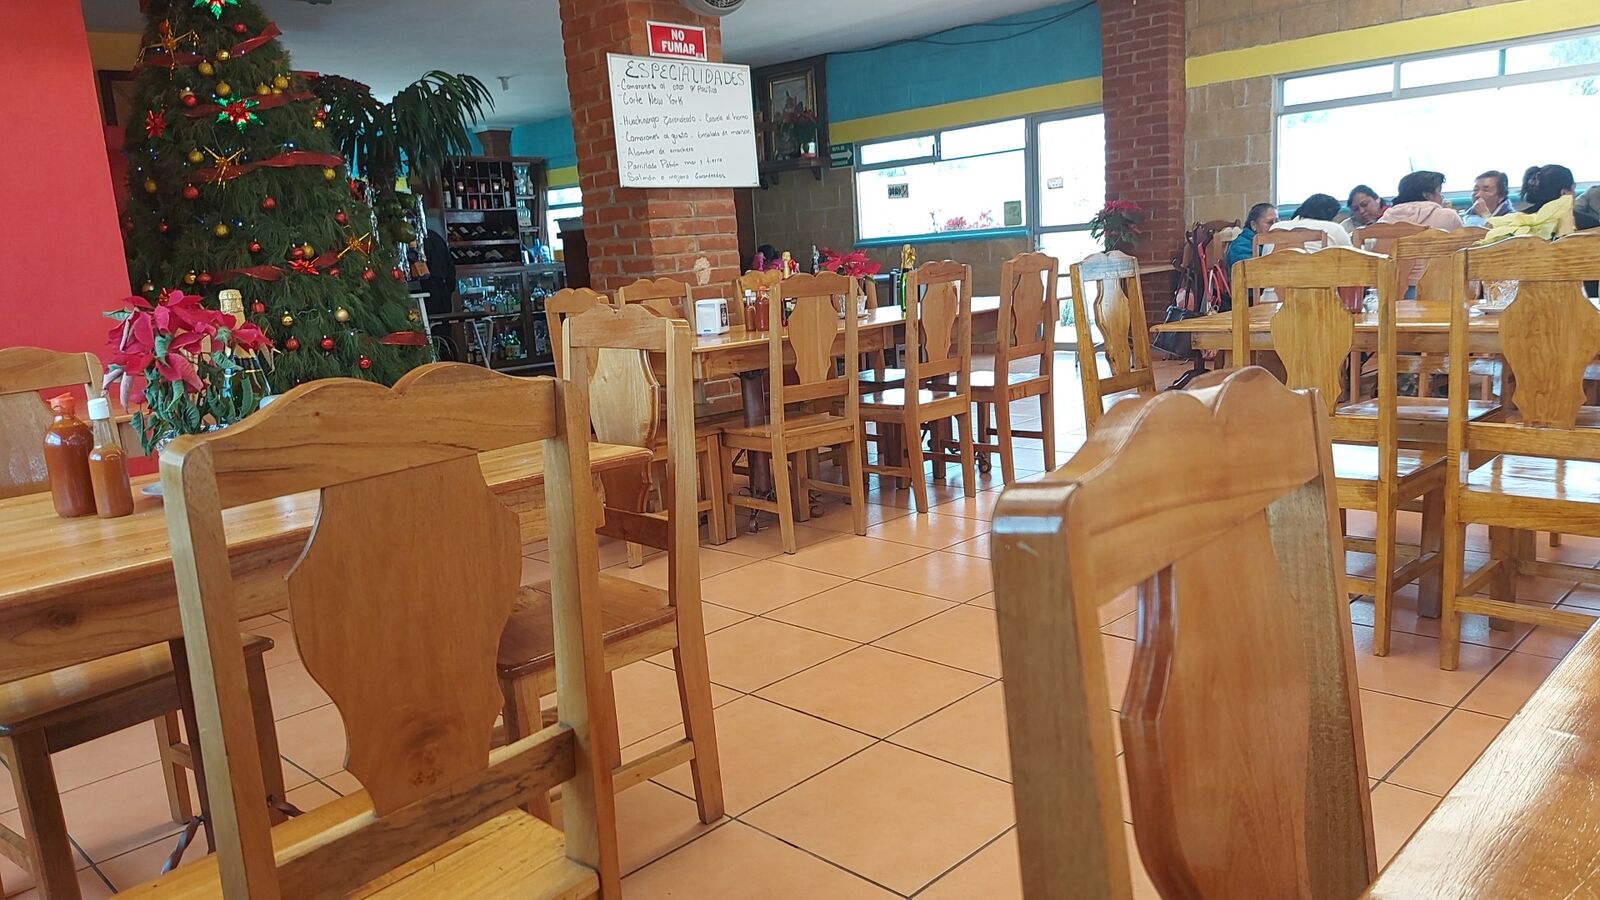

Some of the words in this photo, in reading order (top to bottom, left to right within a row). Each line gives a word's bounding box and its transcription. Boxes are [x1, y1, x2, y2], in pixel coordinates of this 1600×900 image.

[671, 29, 685, 41] NO
[661, 40, 696, 55] FUMAR
[625, 60, 745, 86] ESPECIALIDADES
[623, 92, 643, 105] Corte
[647, 92, 664, 106] New
[666, 93, 684, 105] York
